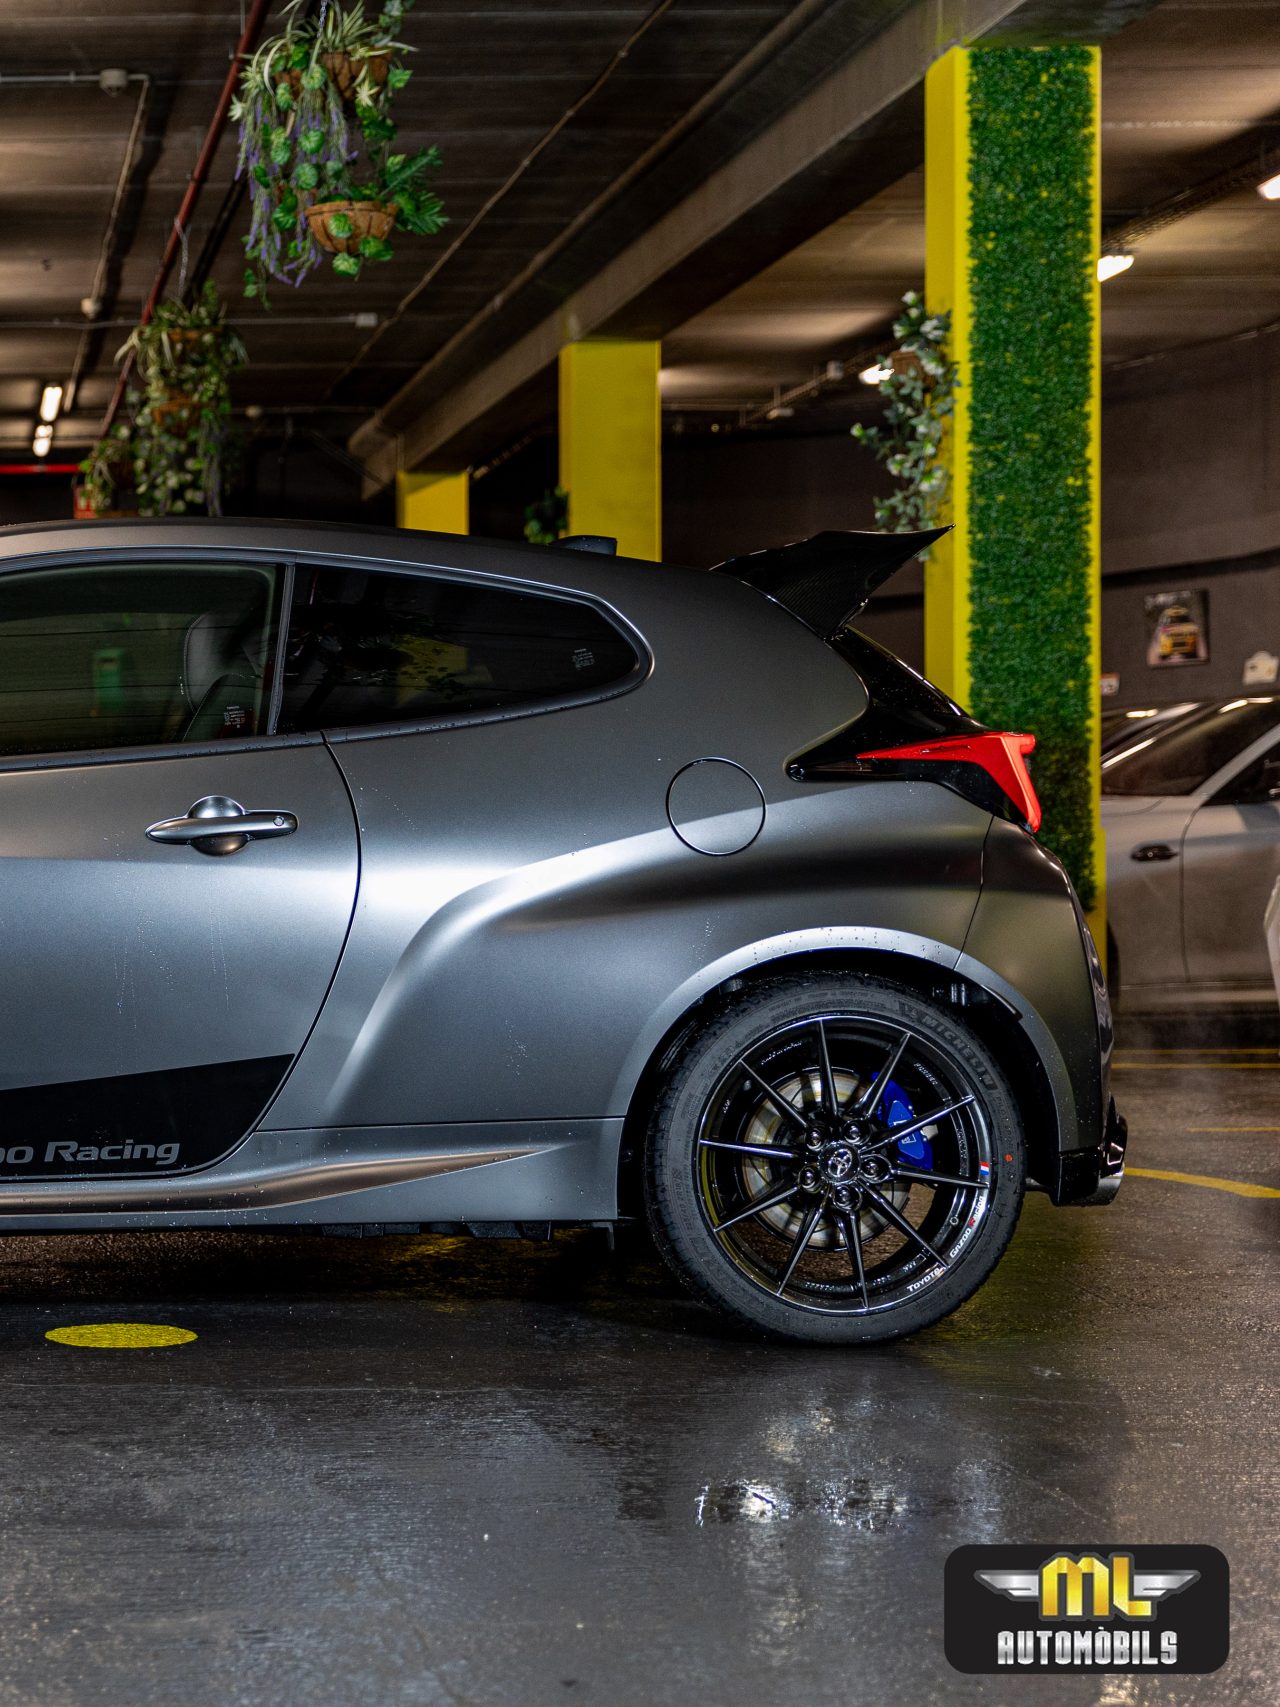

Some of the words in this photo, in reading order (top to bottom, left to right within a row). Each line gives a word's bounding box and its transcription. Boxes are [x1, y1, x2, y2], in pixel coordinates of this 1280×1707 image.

[921, 1011, 994, 1088] MICHELIN
[44, 1140, 180, 1166] Racing
[907, 1266, 947, 1292] TOYOTA
[949, 1228, 972, 1258] GAZOO
[967, 1195, 987, 1227] Racing
